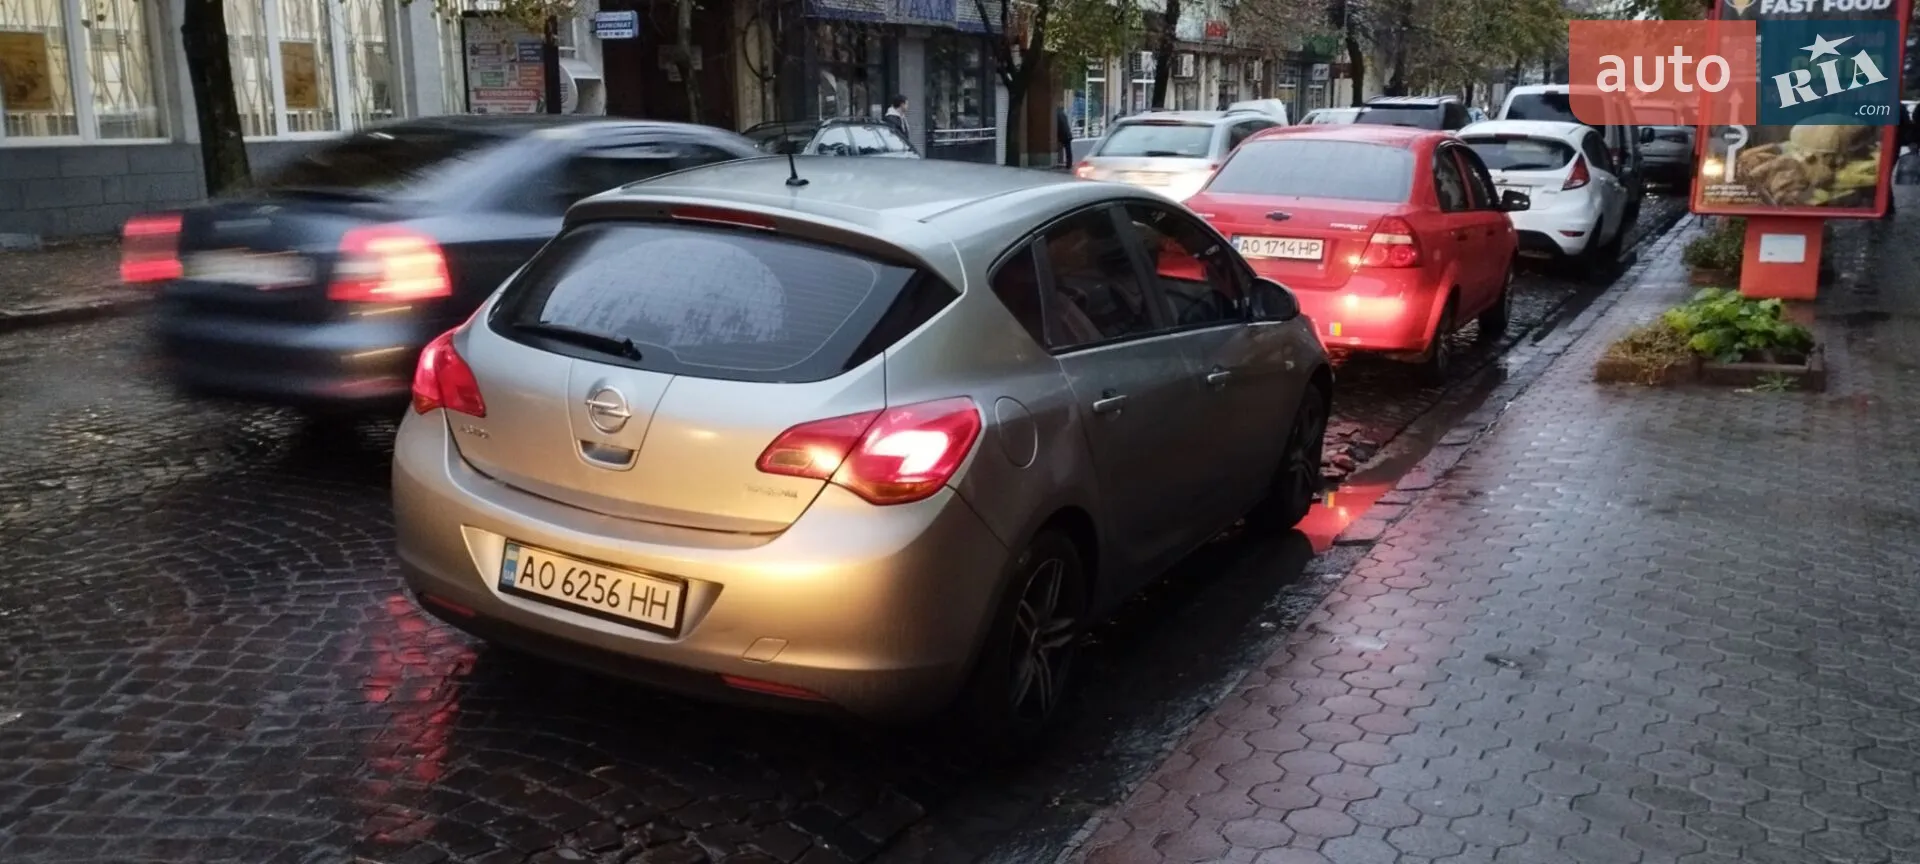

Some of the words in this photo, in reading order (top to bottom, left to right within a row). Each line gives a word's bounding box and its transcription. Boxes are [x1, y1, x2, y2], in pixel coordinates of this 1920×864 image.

[1760, 0, 1818, 14] FAST
[1823, 0, 1892, 12] FOOD
[1264, 240, 1296, 255] 1714
[519, 556, 556, 590] AO
[562, 567, 623, 608] 6256
[628, 582, 671, 621] HH
